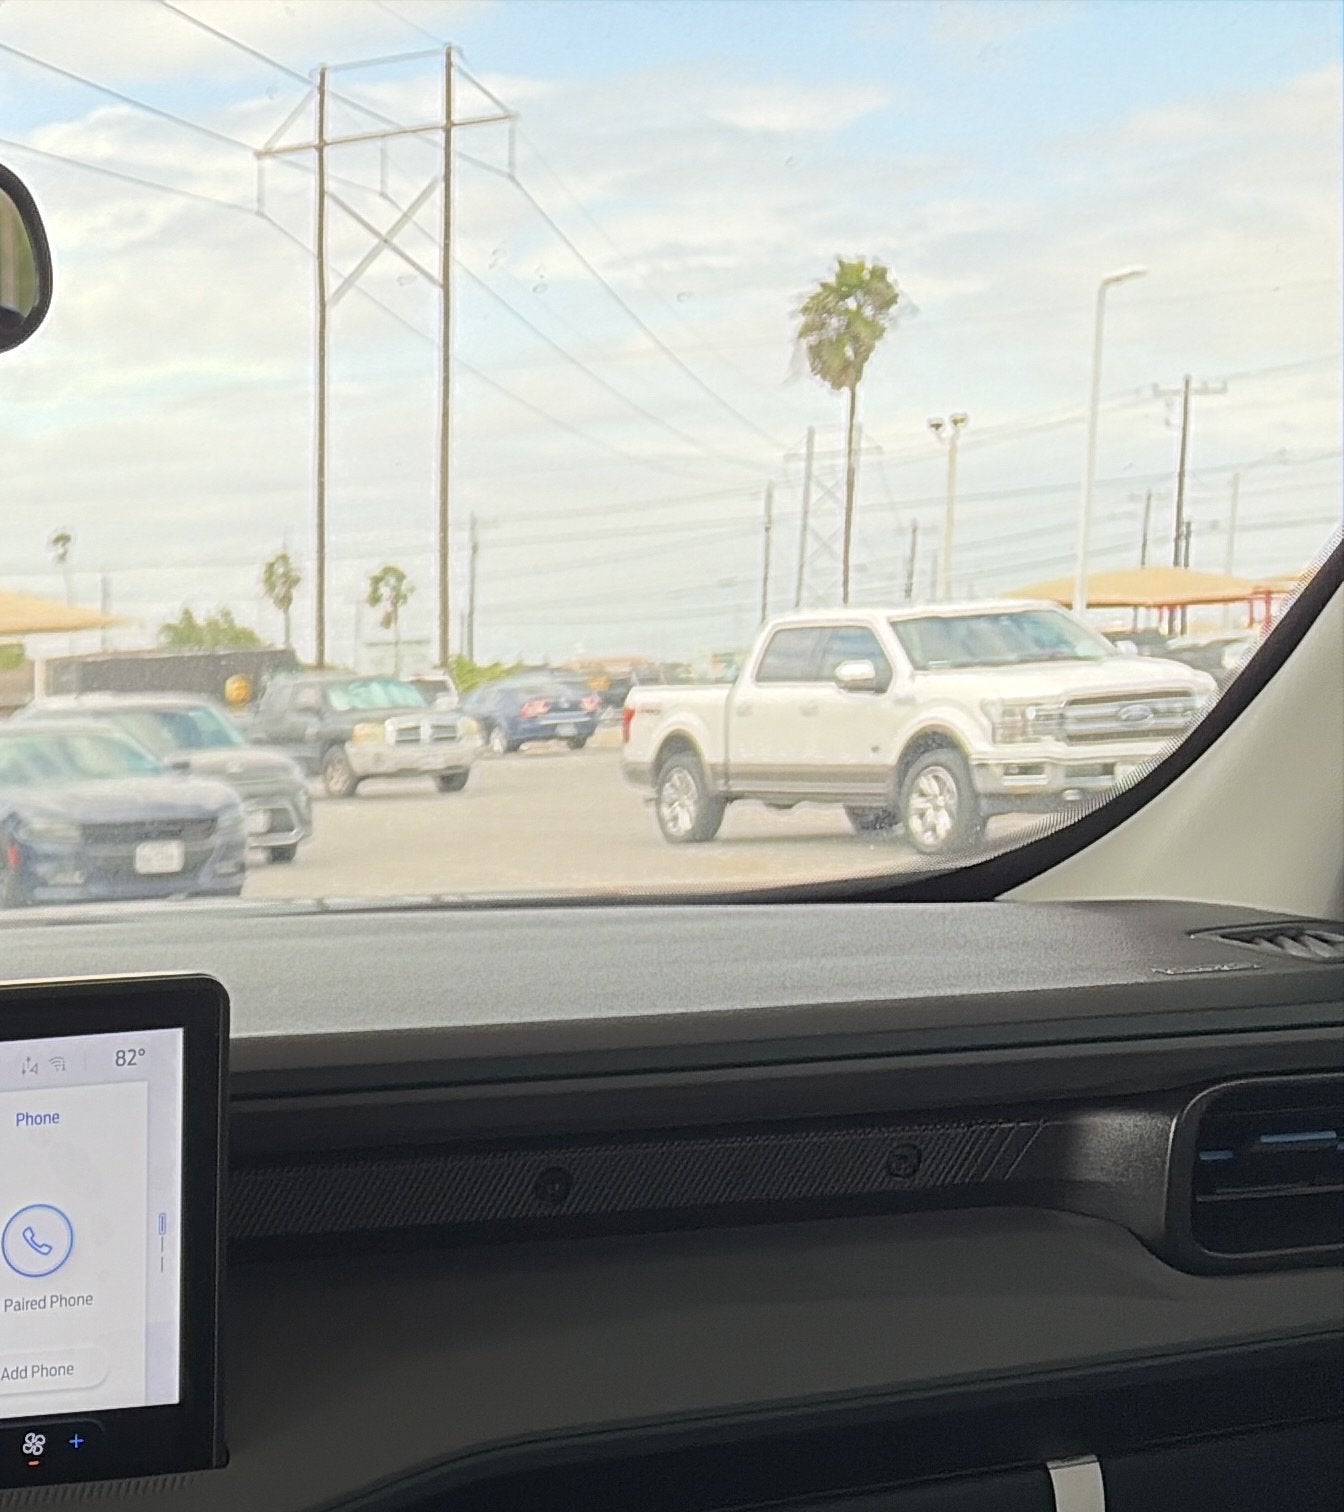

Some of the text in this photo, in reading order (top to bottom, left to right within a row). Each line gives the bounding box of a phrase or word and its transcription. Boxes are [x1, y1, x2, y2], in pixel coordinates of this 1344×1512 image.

[115, 1048, 146, 1067] 82°
[16, 1111, 60, 1127] Phone
[4, 1296, 47, 1313] Paired
[49, 1293, 93, 1309] Phone
[0, 1363, 74, 1381] Add Phone
